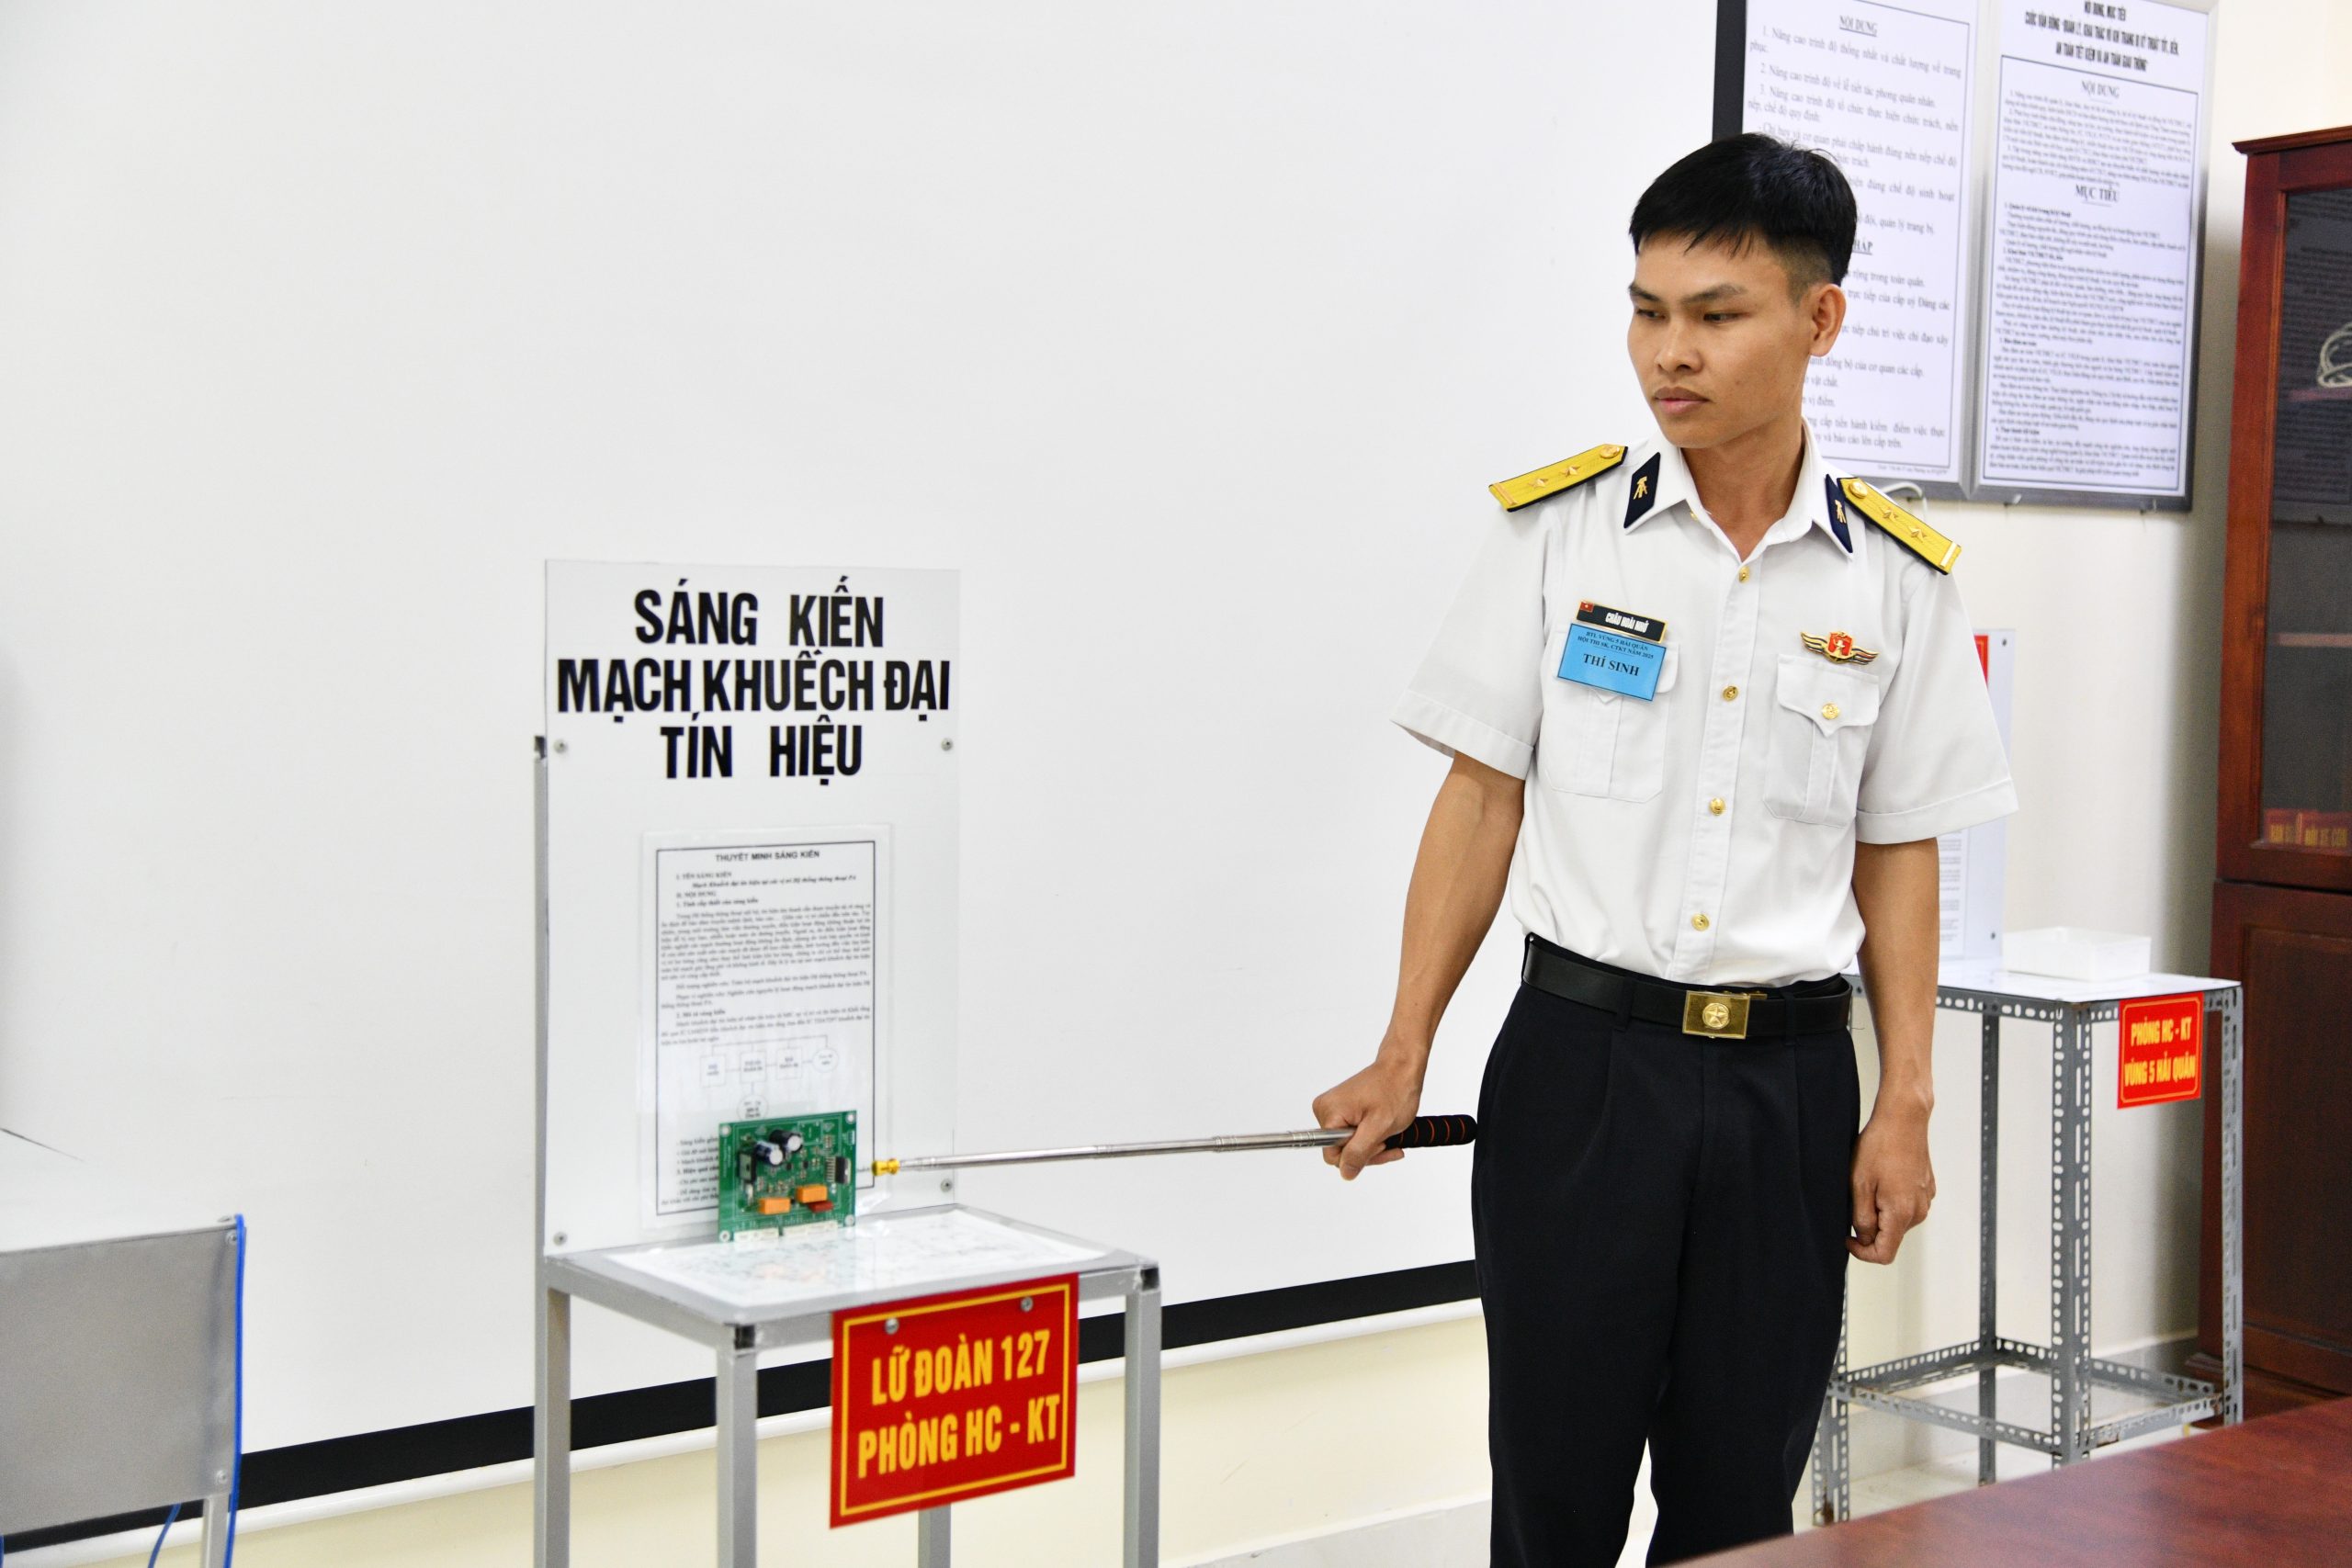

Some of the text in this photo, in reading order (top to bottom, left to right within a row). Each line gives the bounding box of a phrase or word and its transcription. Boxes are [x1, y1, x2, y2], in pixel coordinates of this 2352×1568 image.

[1852, 239, 1872, 253] HÁP
[634, 575, 884, 648] SÁNG KIẾN
[558, 649, 951, 723] MẠCH KHUẾCH ĐẠI
[1583, 653, 1640, 676] THÍ SINH
[660, 711, 862, 786] TÍN HIỆU
[716, 850, 820, 862] THUYẾT MINH SÁNG KIẾN
[2131, 1016, 2160, 1046] PHÒNG
[2162, 1019, 2174, 1043] HC
[2180, 1017, 2192, 1041] KT
[2124, 1058, 2148, 1087] VÙNG
[2149, 1060, 2155, 1084] 5
[872, 1329, 1050, 1405] LỮ ĐOÀN 127
[858, 1394, 1060, 1479] PHÒNG HC - KT
